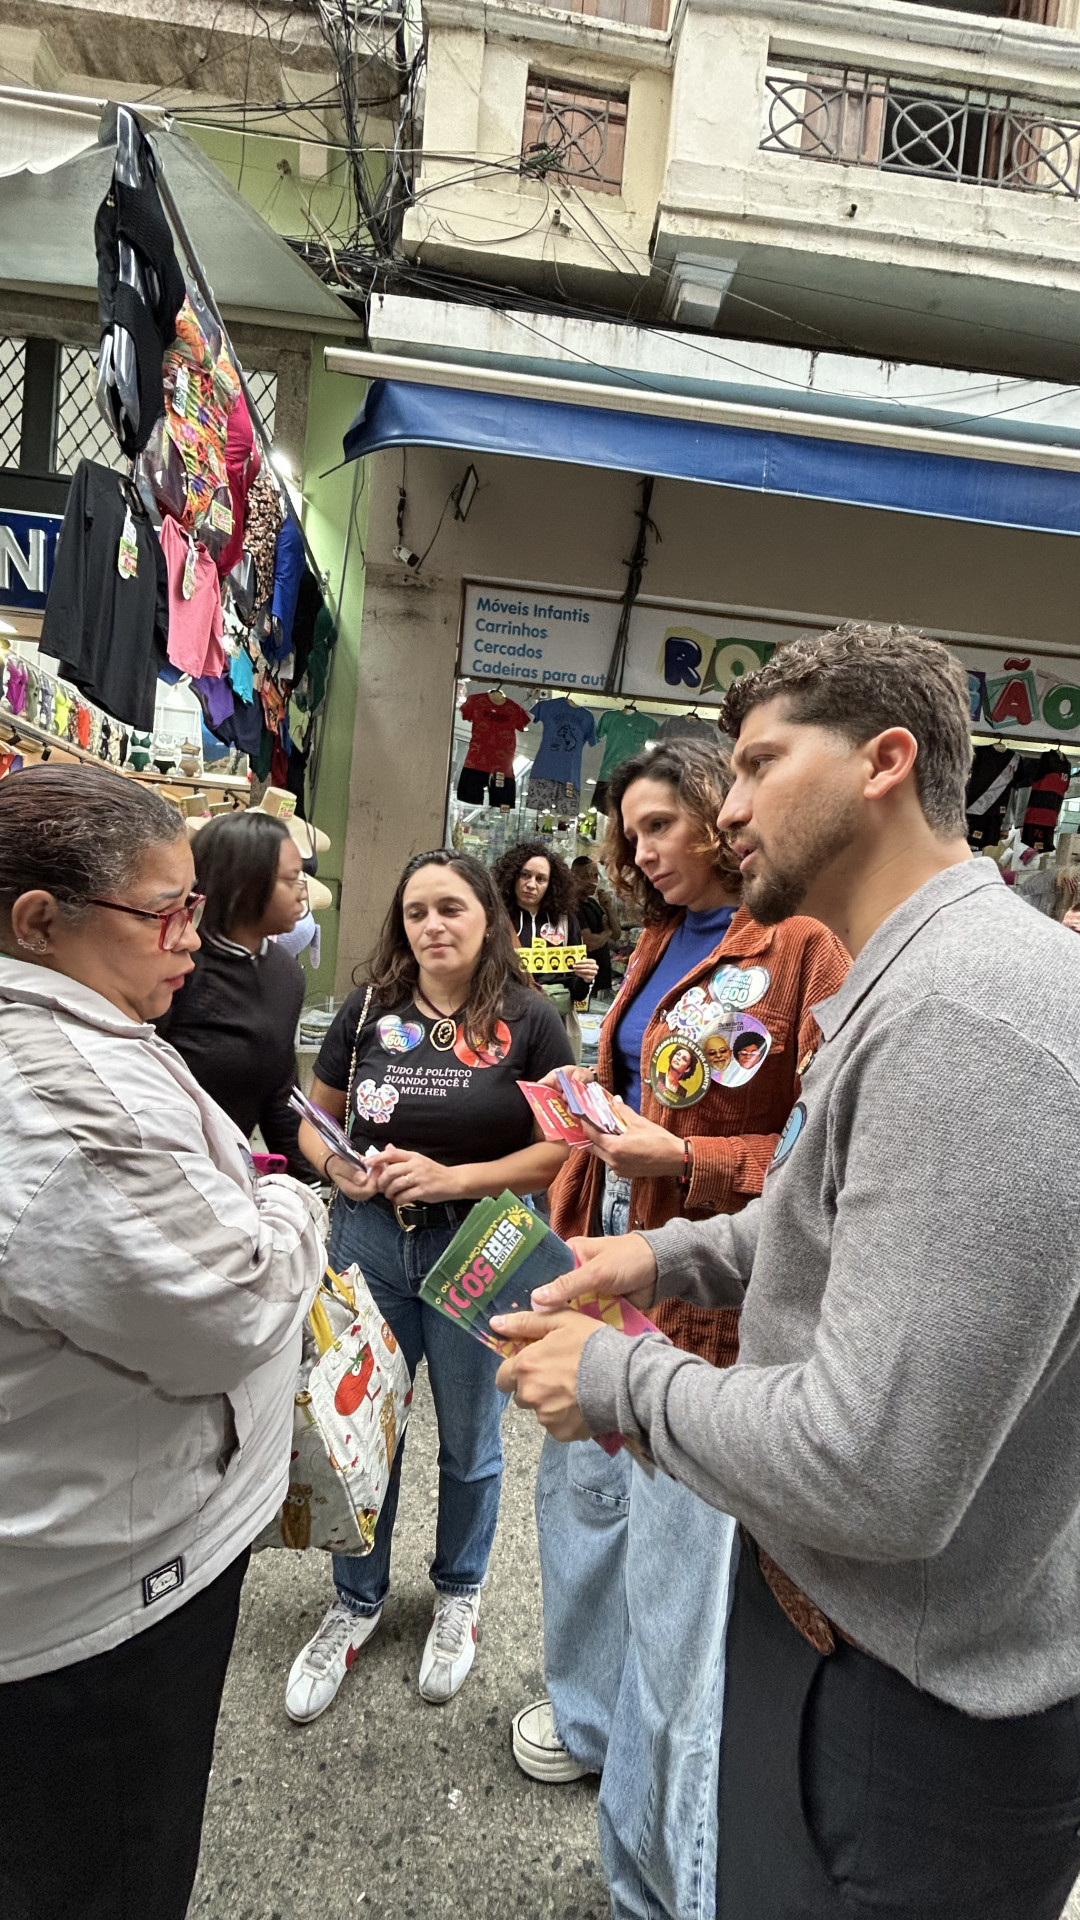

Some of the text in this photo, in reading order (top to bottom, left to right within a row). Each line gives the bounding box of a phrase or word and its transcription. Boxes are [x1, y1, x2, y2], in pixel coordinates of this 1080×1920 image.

[0, 526, 60, 592] N
[476, 597, 590, 623] Móveis Infantis
[475, 618, 548, 639] Carrinhos
[474, 639, 543, 659] Cercados
[472, 659, 607, 687] Cadeiras para aut
[720, 987, 749, 1003] 500
[387, 1034, 409, 1047] 500
[386, 1064, 472, 1078] TUDO É POLÍTICO
[384, 1075, 470, 1088] QUANDO VOCÊ É
[400, 1086, 447, 1096] MULHER
[365, 1096, 381, 1112] 50
[494, 1233, 521, 1267] WILLIAM
[462, 1256, 495, 1298] 50
